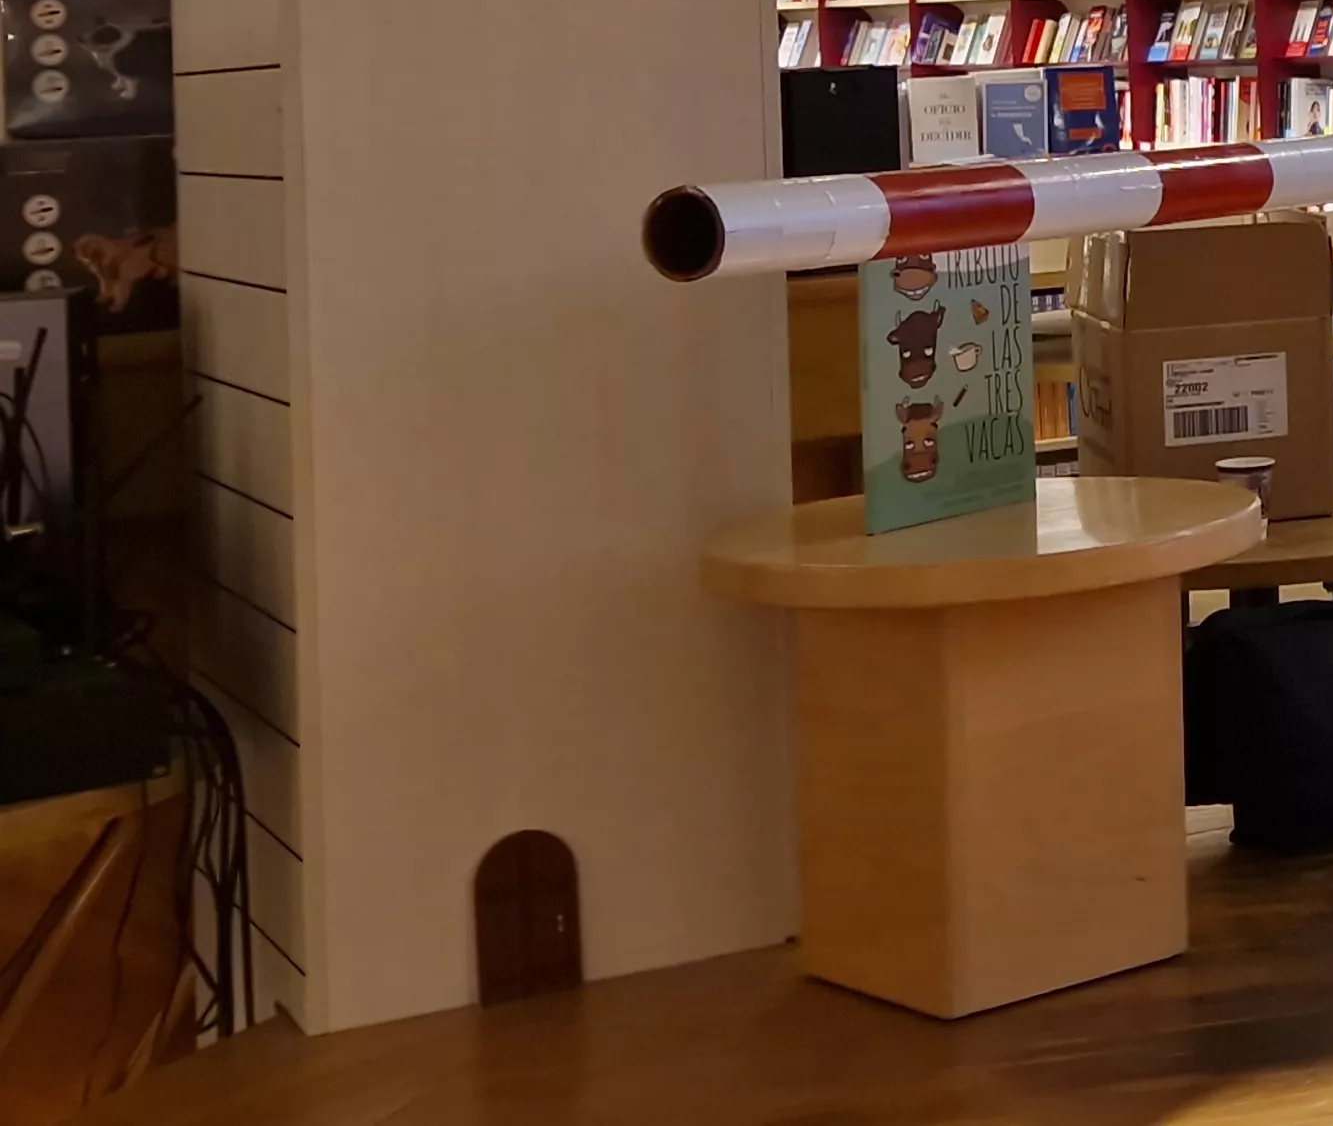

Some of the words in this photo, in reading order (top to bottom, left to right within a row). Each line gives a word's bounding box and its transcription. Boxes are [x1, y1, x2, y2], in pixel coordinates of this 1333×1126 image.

[1000, 282, 1022, 326] DE
[991, 325, 1023, 372] LAS
[984, 368, 1024, 416] TRES
[964, 413, 1025, 463] VACAS
